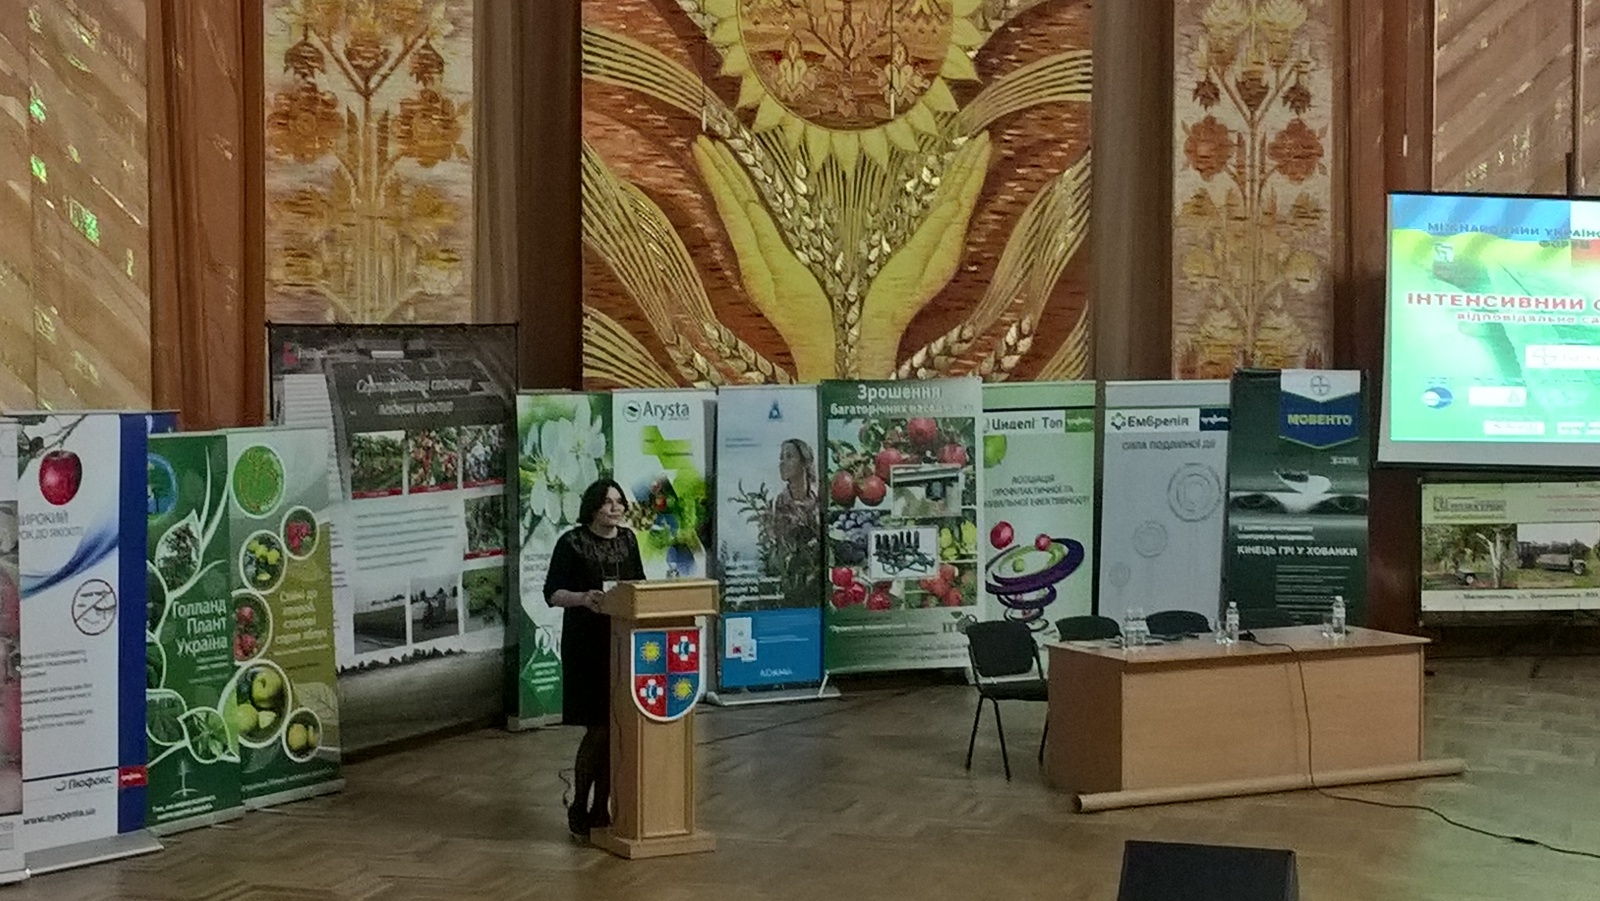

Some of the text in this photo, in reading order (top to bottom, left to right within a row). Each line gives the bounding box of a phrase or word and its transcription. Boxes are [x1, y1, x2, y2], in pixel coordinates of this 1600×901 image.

[857, 383, 942, 403] Зрошення
[643, 401, 690, 421] Arysta
[829, 402, 908, 417] багаторічних
[1286, 413, 1354, 427] МОВЕНТО
[1236, 545, 1277, 558] КІНЕЦЬ
[1305, 547, 1359, 560] ХОВАНКИ
[172, 598, 228, 620] Голланд
[186, 616, 228, 636] Плант
[176, 635, 229, 660] Україна
